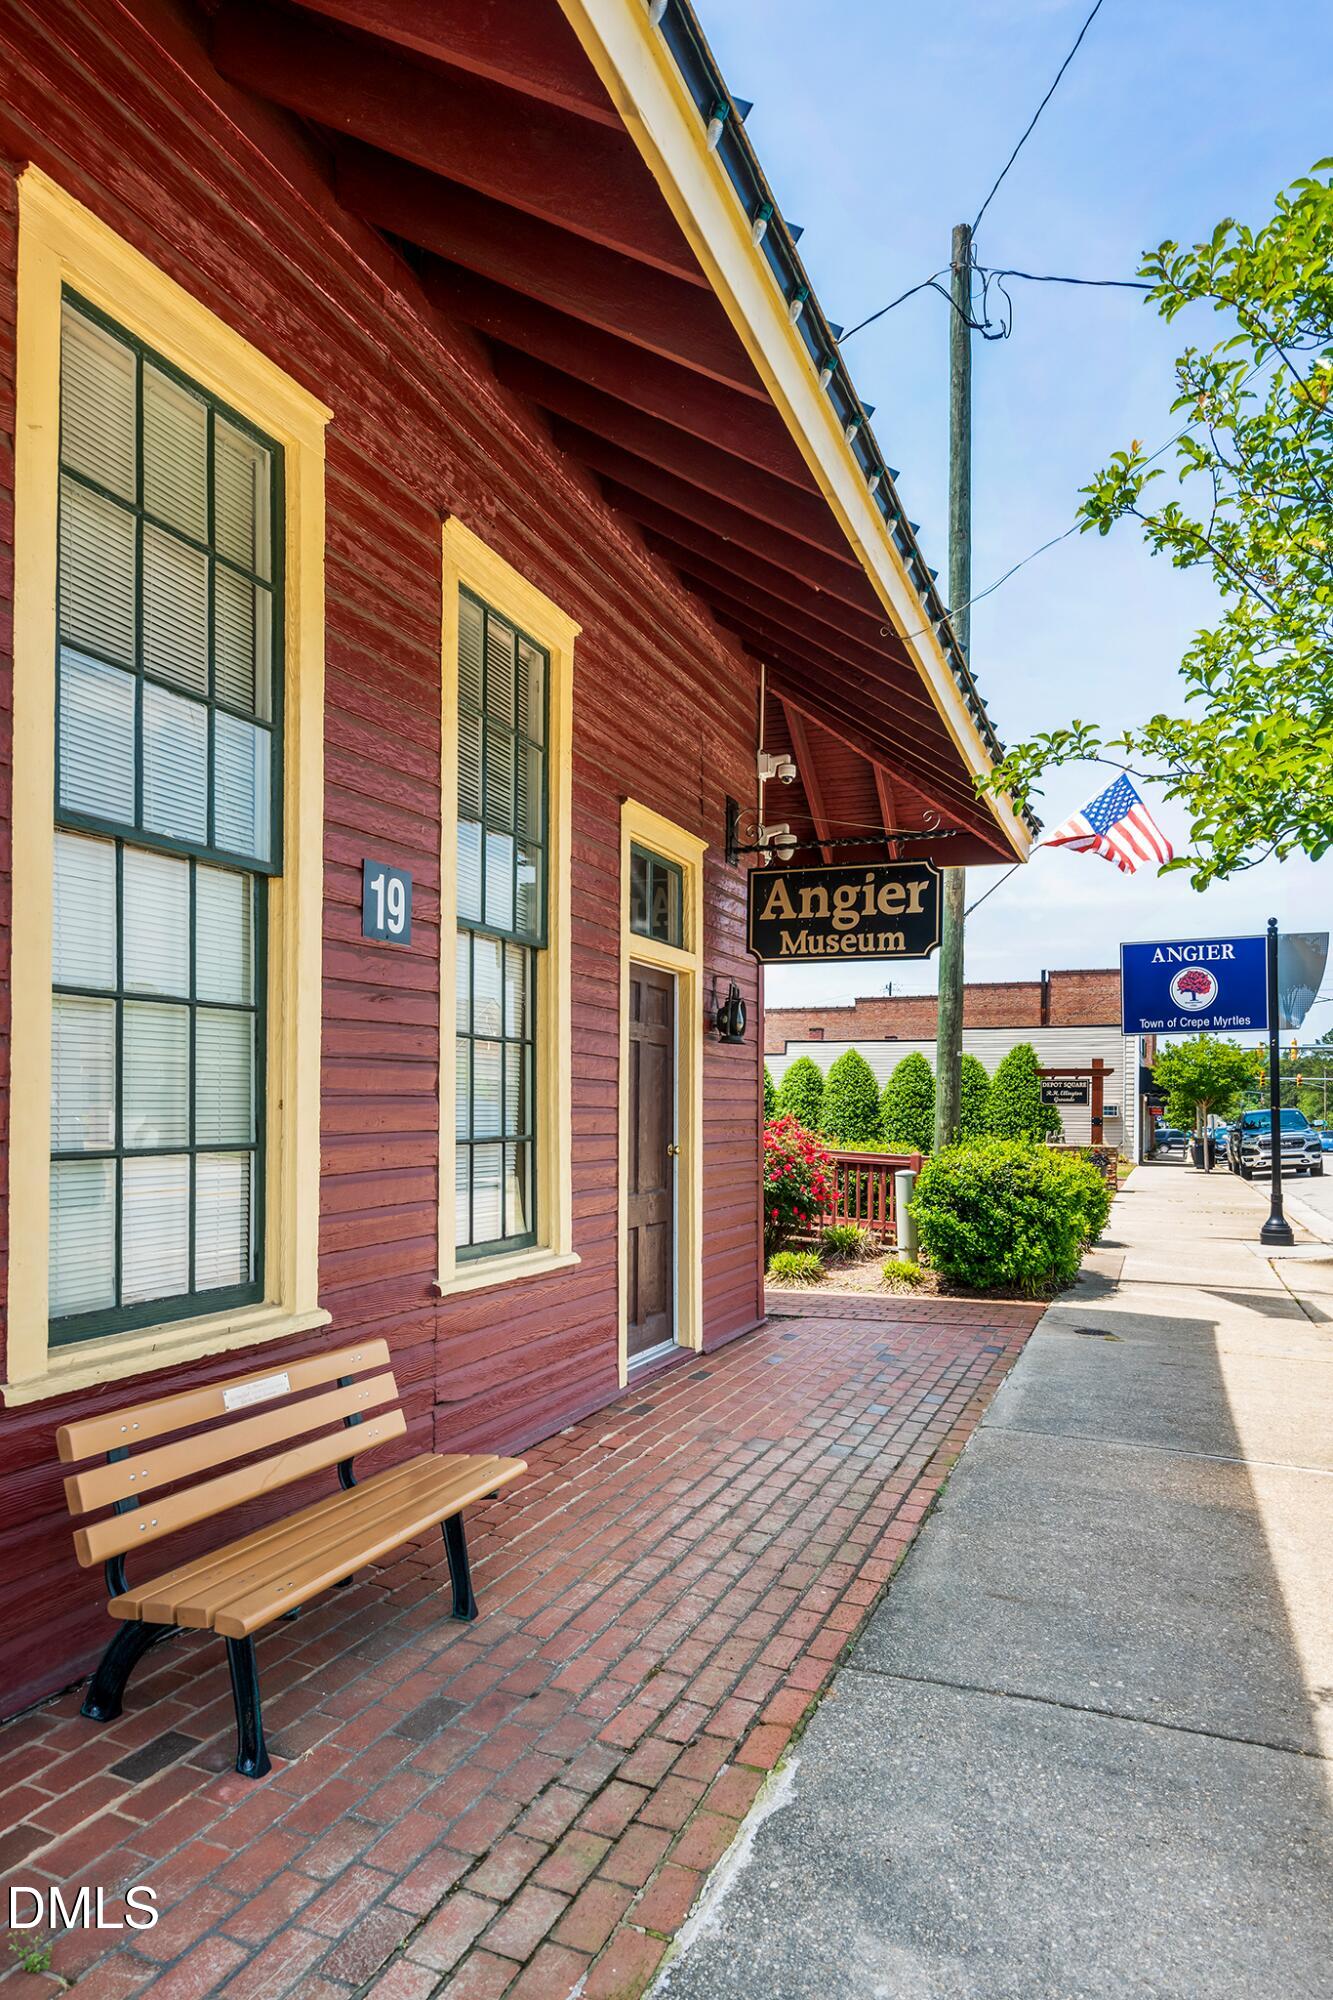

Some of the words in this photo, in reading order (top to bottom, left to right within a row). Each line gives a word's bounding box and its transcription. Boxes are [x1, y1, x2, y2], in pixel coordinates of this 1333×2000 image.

[371, 873, 405, 934] 19
[759, 872, 929, 931] Angier
[780, 929, 906, 955] Museum
[1151, 943, 1236, 963] ANGIER
[1139, 1018, 1164, 1028] Town
[1167, 1017, 1177, 1028] of
[1180, 1017, 1210, 1029] Crepe
[1213, 1015, 1251, 1028] Myrtles
